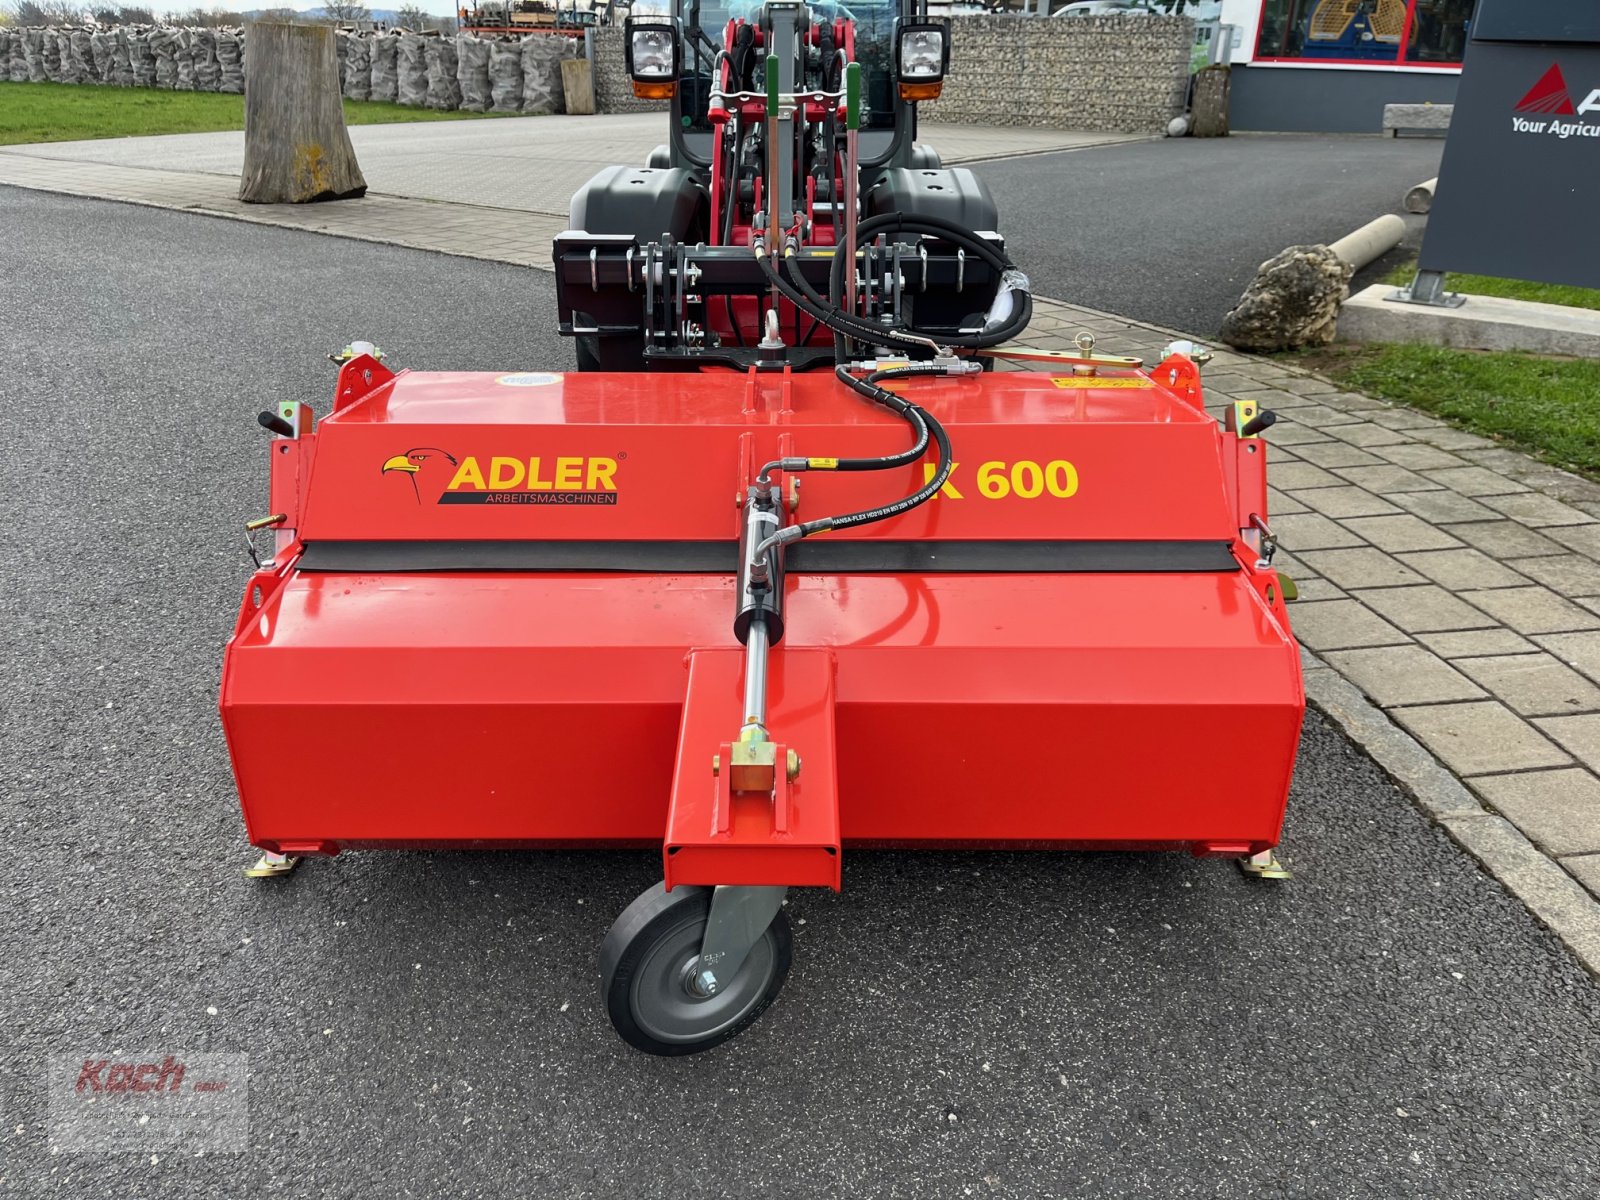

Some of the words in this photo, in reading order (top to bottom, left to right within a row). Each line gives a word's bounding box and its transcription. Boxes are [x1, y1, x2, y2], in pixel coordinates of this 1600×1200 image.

[1512, 117, 1547, 133] Your
[446, 456, 618, 491] ADLER
[923, 462, 965, 499] K
[976, 459, 1079, 499] 600
[485, 493, 615, 505] ARBEITSMASCHINEN
[832, 513, 867, 525] HANSA-FLEX
